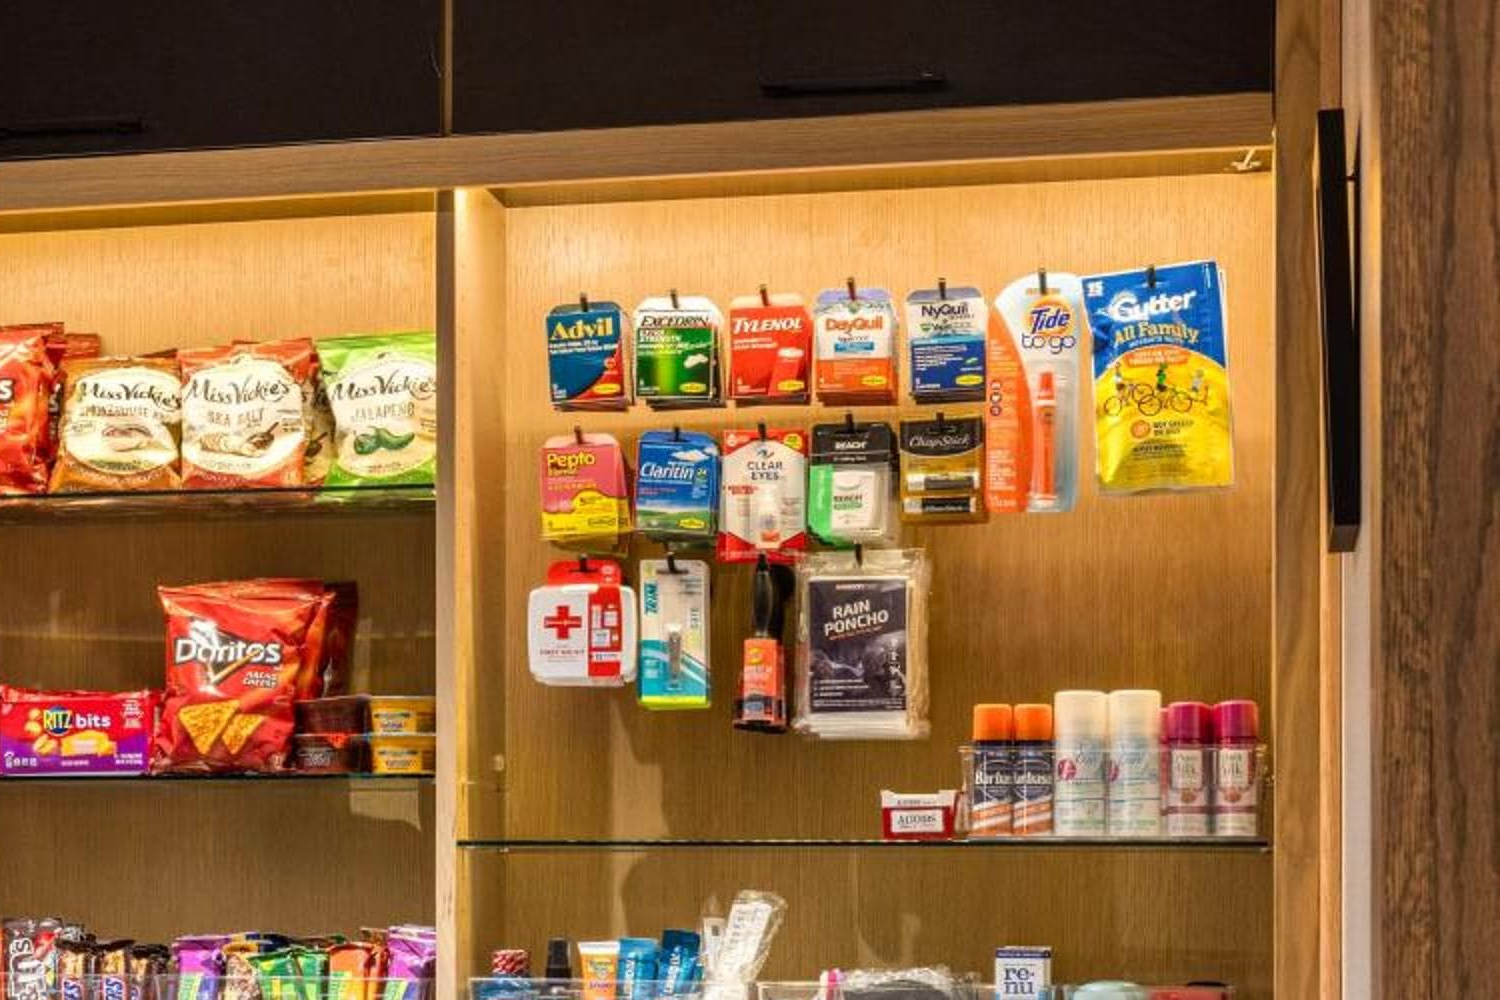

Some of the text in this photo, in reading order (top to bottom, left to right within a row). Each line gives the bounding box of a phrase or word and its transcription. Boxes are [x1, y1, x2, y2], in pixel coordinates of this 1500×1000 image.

[921, 302, 969, 318] NyQuil
[1100, 288, 1197, 323] Cutter
[550, 317, 613, 341] Advil
[732, 315, 804, 333] TYLENOL
[825, 315, 884, 335] DayQuil
[1030, 307, 1071, 334] Tide
[1114, 321, 1200, 343] All Family
[1021, 334, 1077, 355] to go
[78, 381, 182, 412] Miss Vickie's
[186, 375, 290, 404] Miss Vickie's
[332, 383, 377, 401] Miss
[835, 440, 868, 449] REACH
[909, 435, 970, 448] ChapStick
[547, 451, 595, 468] Pepto
[747, 462, 783, 471] CLEAR
[639, 461, 695, 481] Claritin
[751, 472, 779, 480] EYES
[832, 599, 871, 620] RAIN
[824, 609, 890, 637] PONCHO
[174, 637, 282, 665] Doritos
[43, 710, 73, 730] RITZ
[75, 713, 111, 729] bits
[1004, 981, 1034, 994] nu
